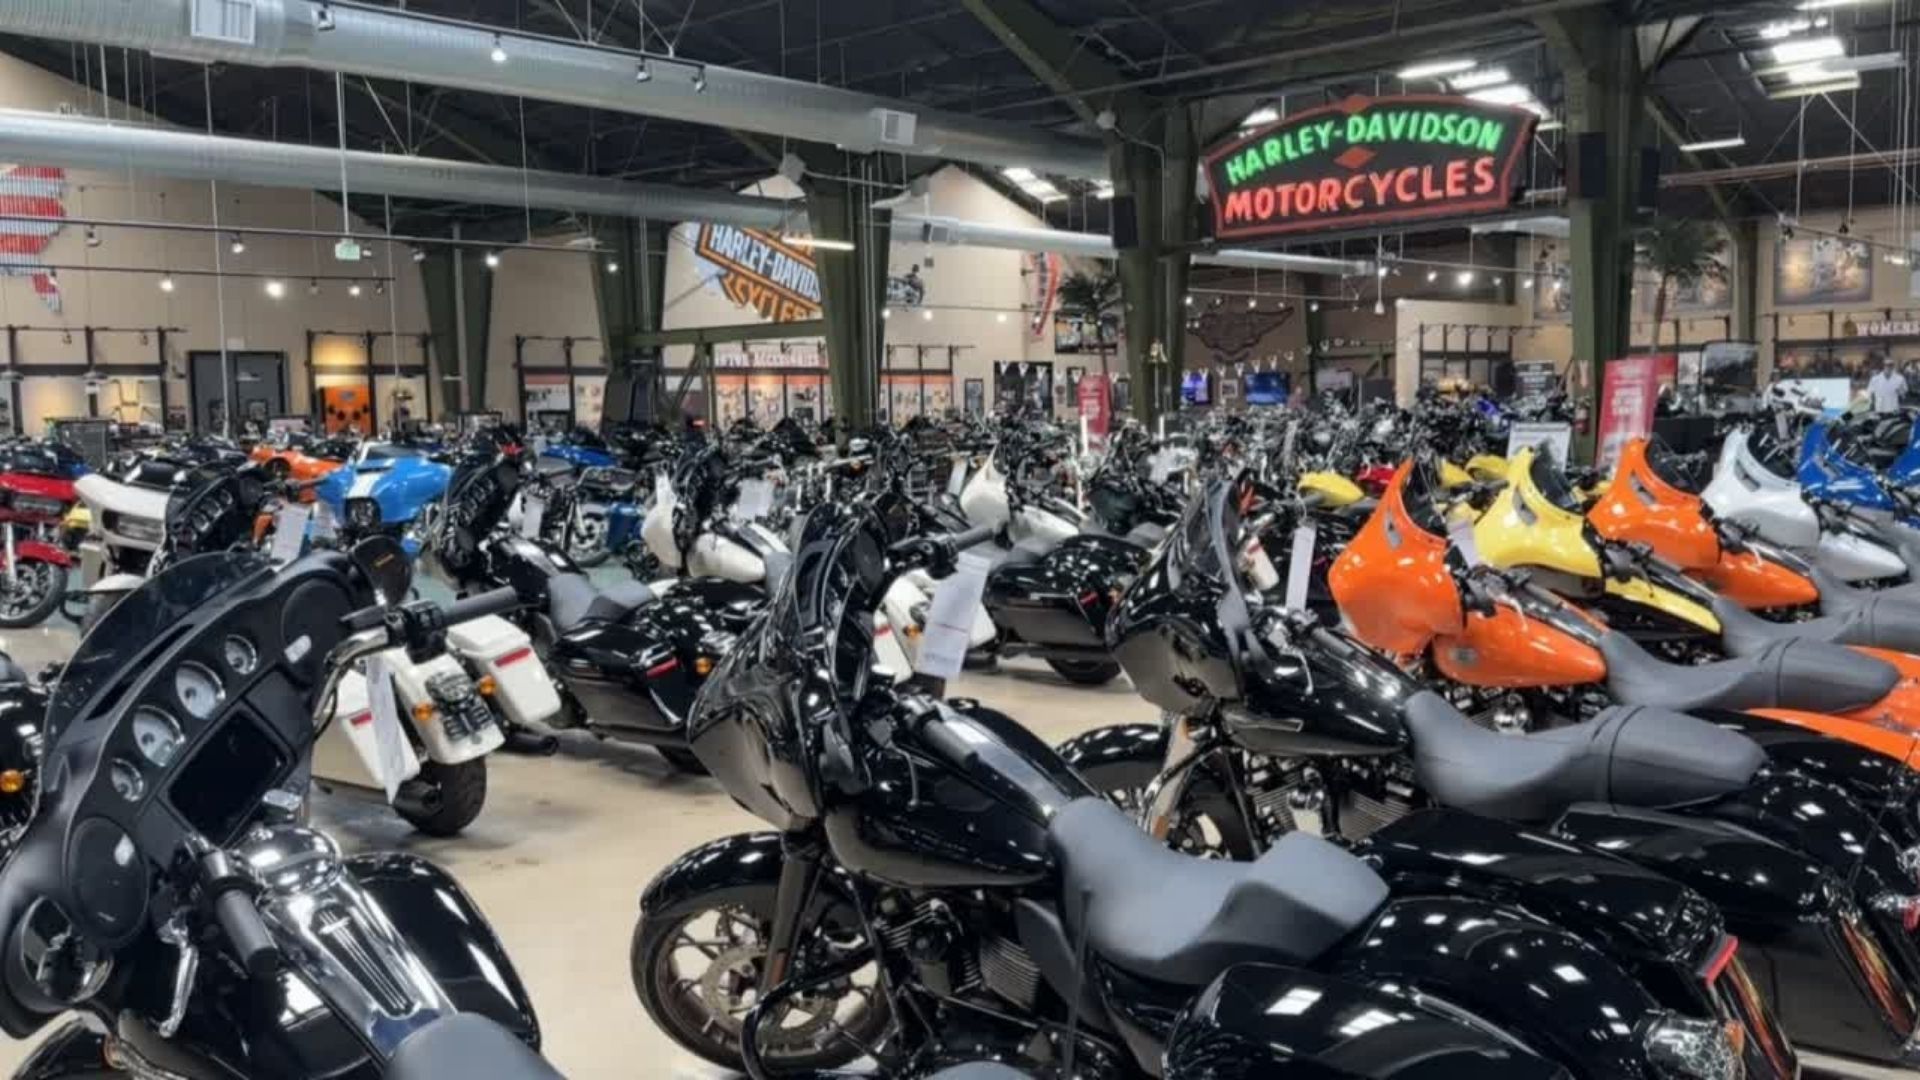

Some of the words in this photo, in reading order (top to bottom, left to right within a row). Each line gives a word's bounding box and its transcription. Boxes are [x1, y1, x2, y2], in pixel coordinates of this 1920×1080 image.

[1225, 111, 1504, 186] HARLEY-DAVIDSON
[1224, 156, 1496, 224] MOTORCYCLES
[709, 224, 821, 302] HARLEY-DAVID
